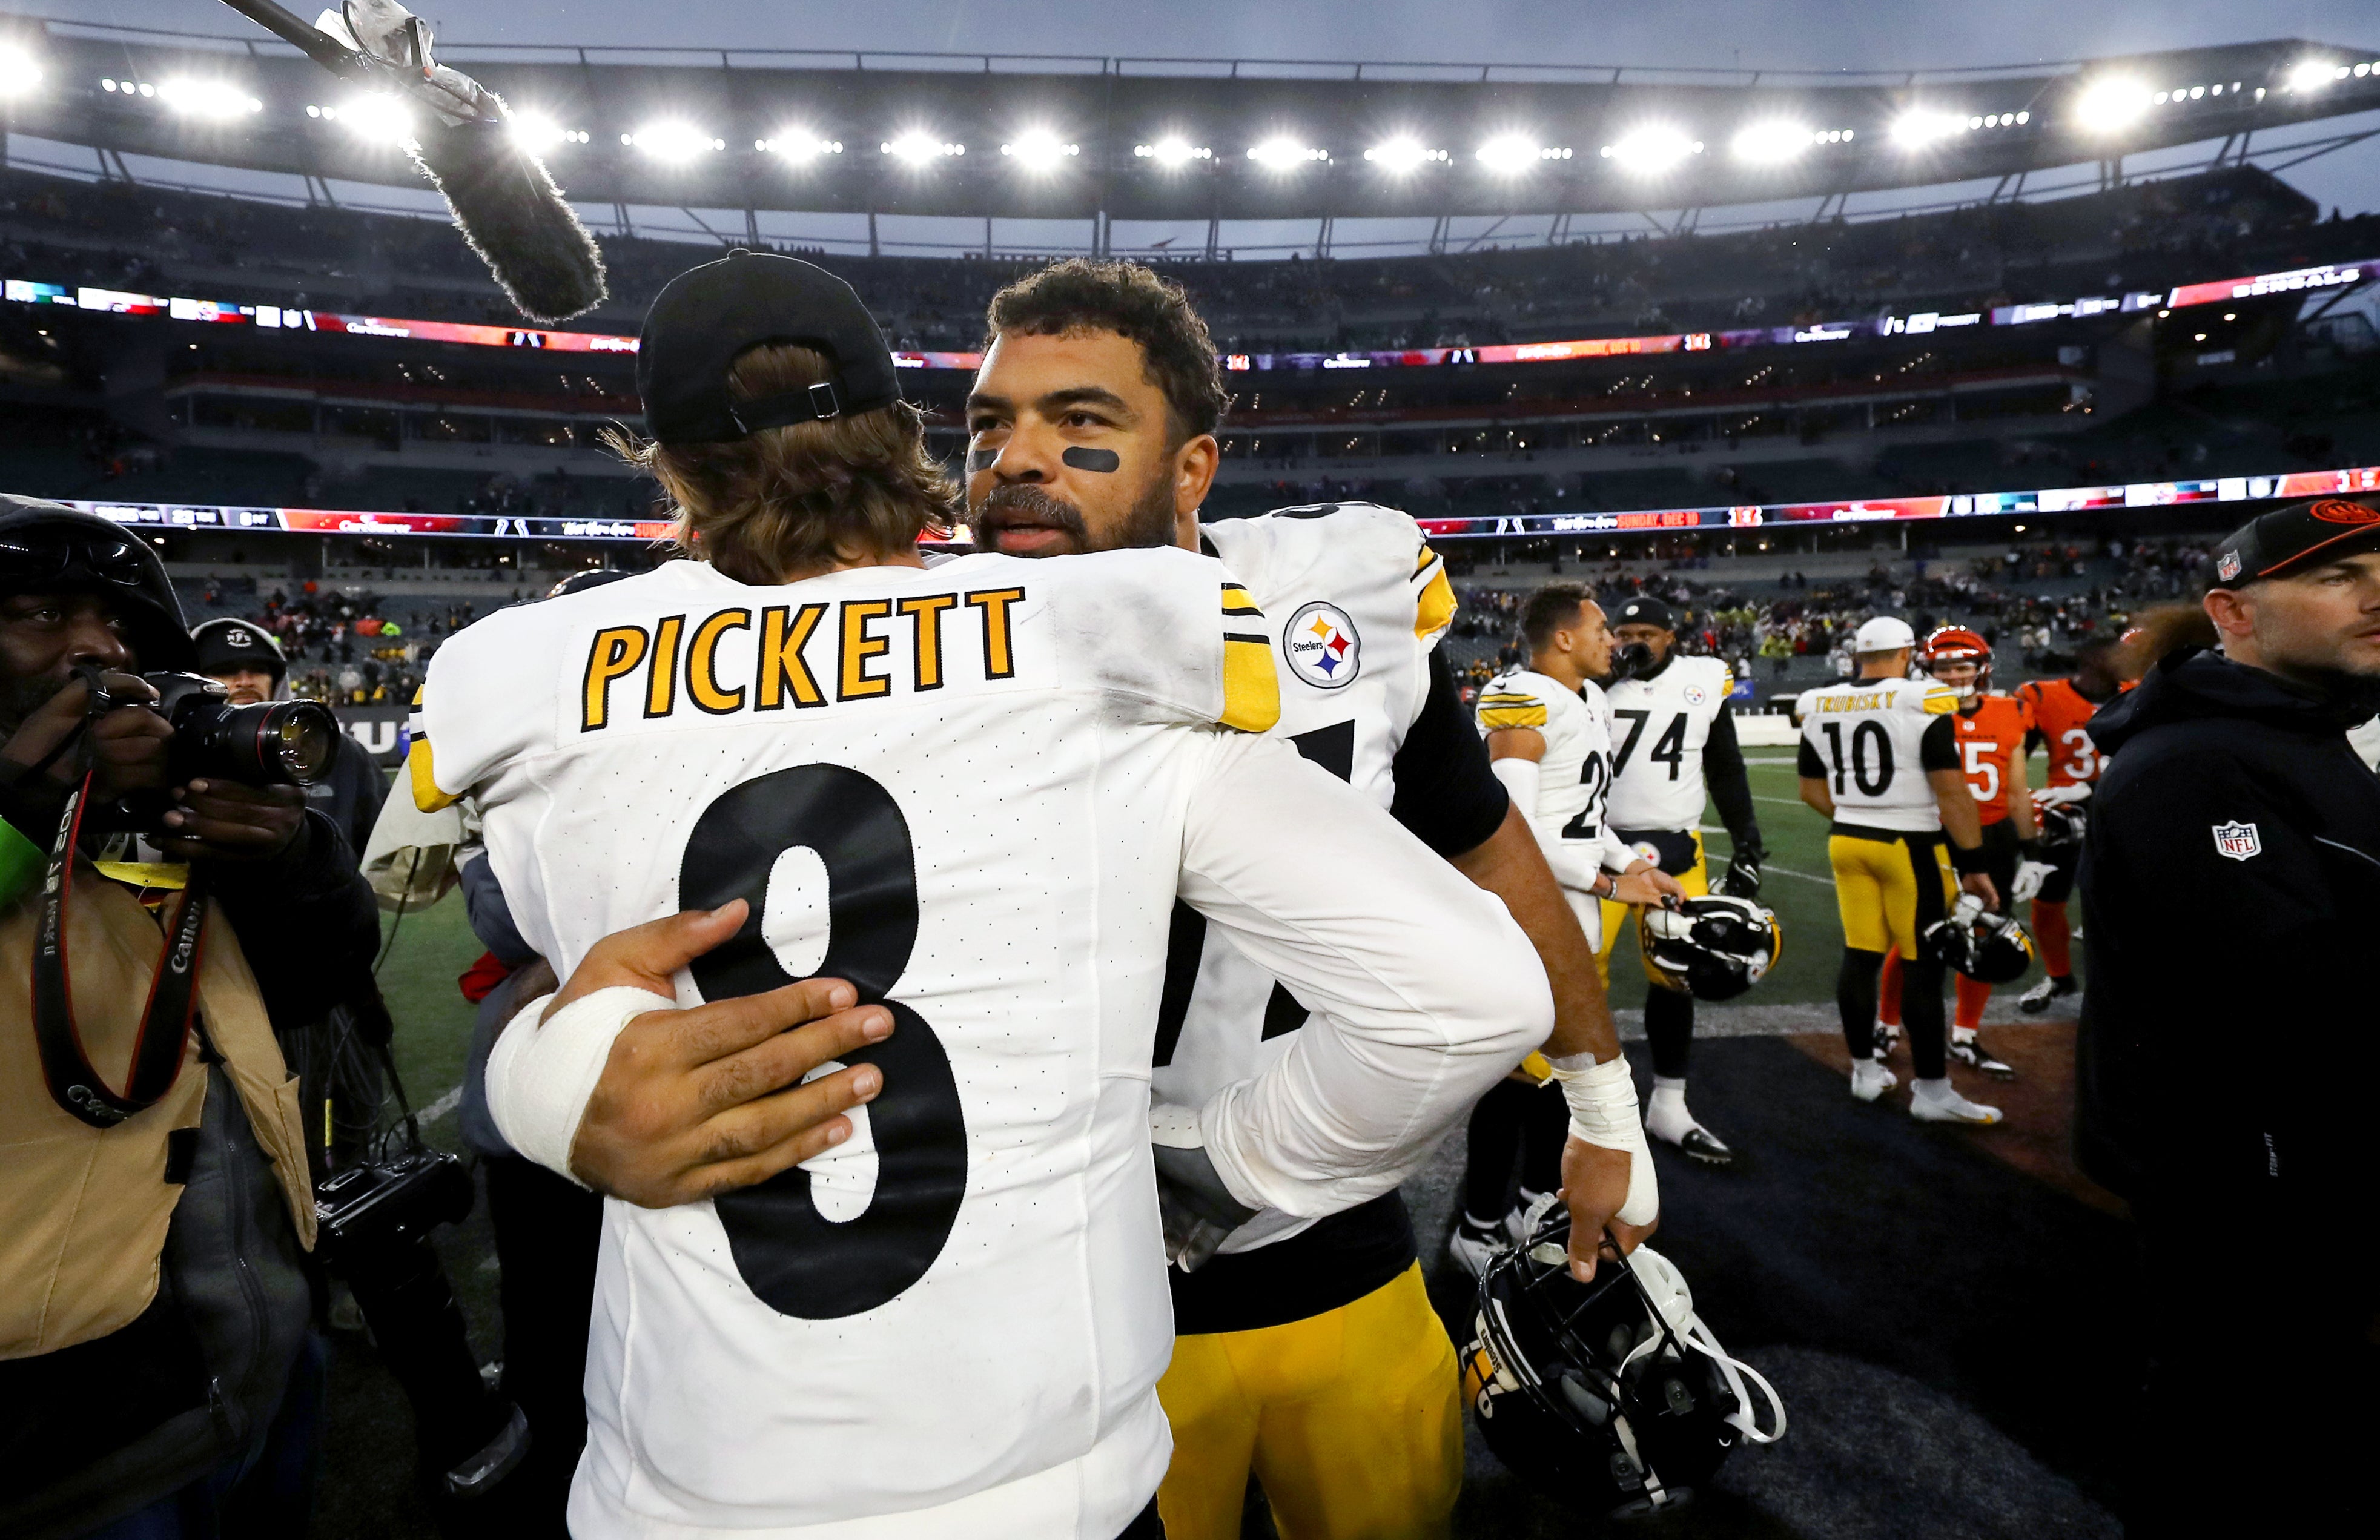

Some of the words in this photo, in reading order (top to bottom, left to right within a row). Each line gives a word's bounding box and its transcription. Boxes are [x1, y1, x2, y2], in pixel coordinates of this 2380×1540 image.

[2232, 268, 2360, 299] BENGALS
[1662, 512, 1686, 527] DEC
[1685, 511, 1700, 526] 10
[580, 586, 1026, 733] PICKETT
[1292, 641, 1324, 653] Steelers
[1815, 690, 1898, 713] TRUBISKY
[1612, 709, 1688, 781] 74
[1822, 720, 1895, 798] 10
[1954, 741, 2000, 802] 5
[2224, 839, 2253, 853] NFL
[171, 900, 202, 974] Canon
[678, 762, 968, 1320] 8
[1480, 1328, 1502, 1374] Steelers
